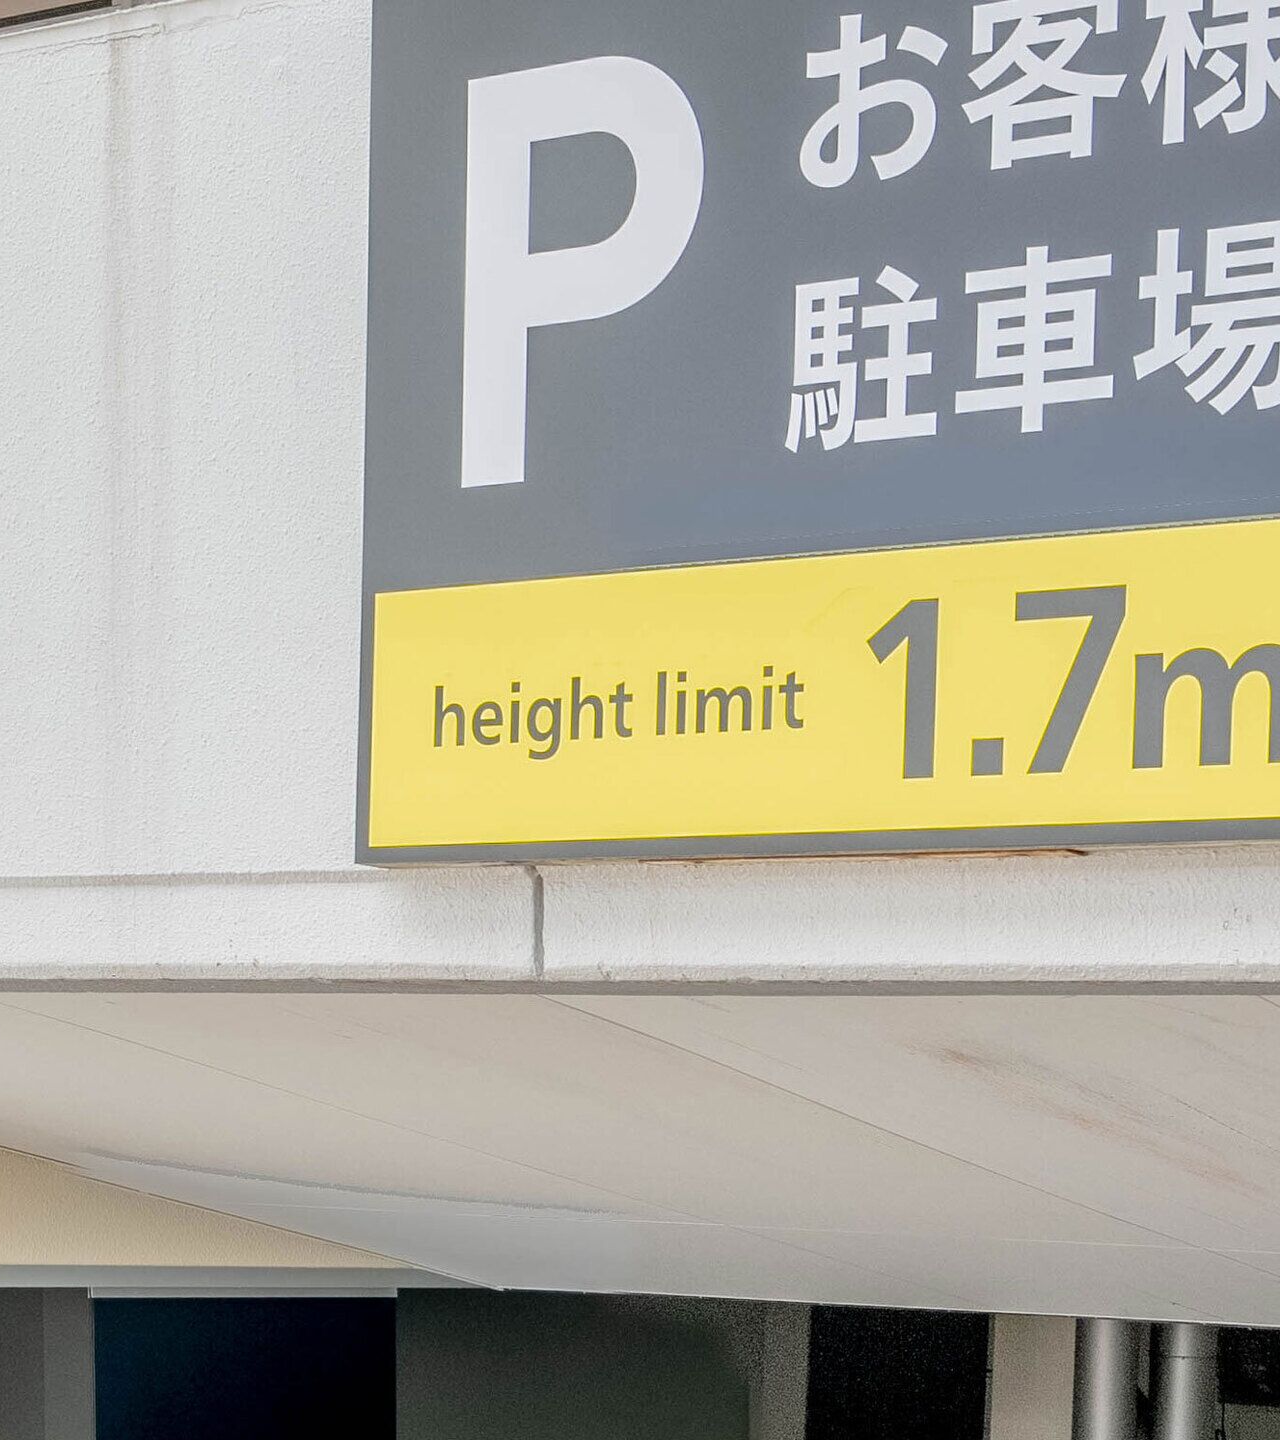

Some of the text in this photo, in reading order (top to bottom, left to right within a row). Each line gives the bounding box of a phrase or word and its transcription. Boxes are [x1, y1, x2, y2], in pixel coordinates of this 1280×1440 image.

[461, 56, 704, 488] P
[433, 677, 633, 760] height
[655, 666, 805, 736] limit
